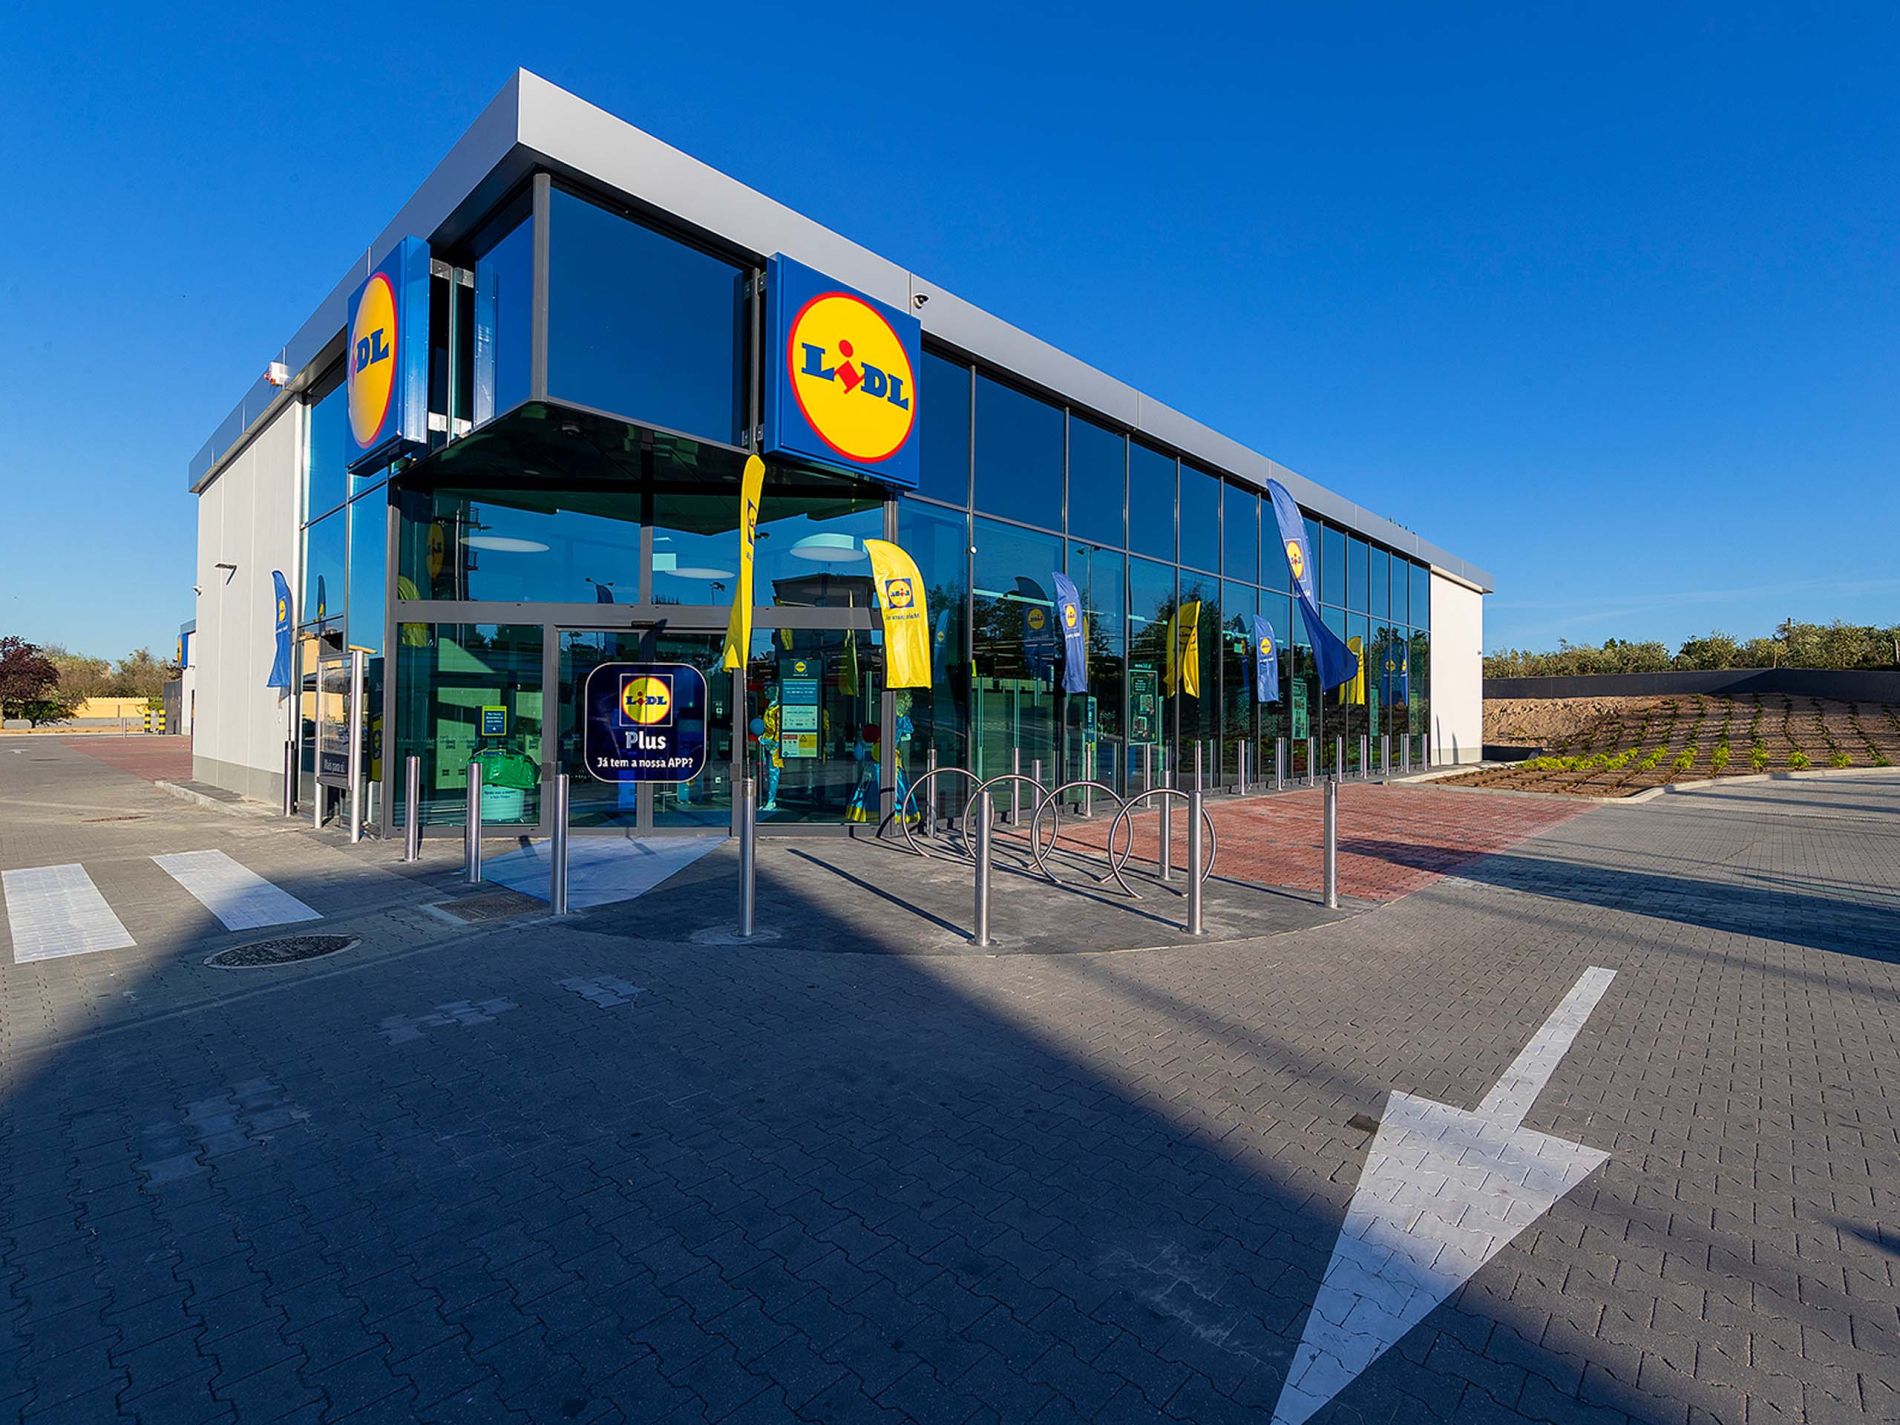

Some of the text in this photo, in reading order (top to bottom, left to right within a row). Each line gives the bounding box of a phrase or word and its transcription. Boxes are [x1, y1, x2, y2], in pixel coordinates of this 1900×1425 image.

[625, 731, 667, 749] Plus
[597, 757, 694, 768] Já tem a nossa APP?
